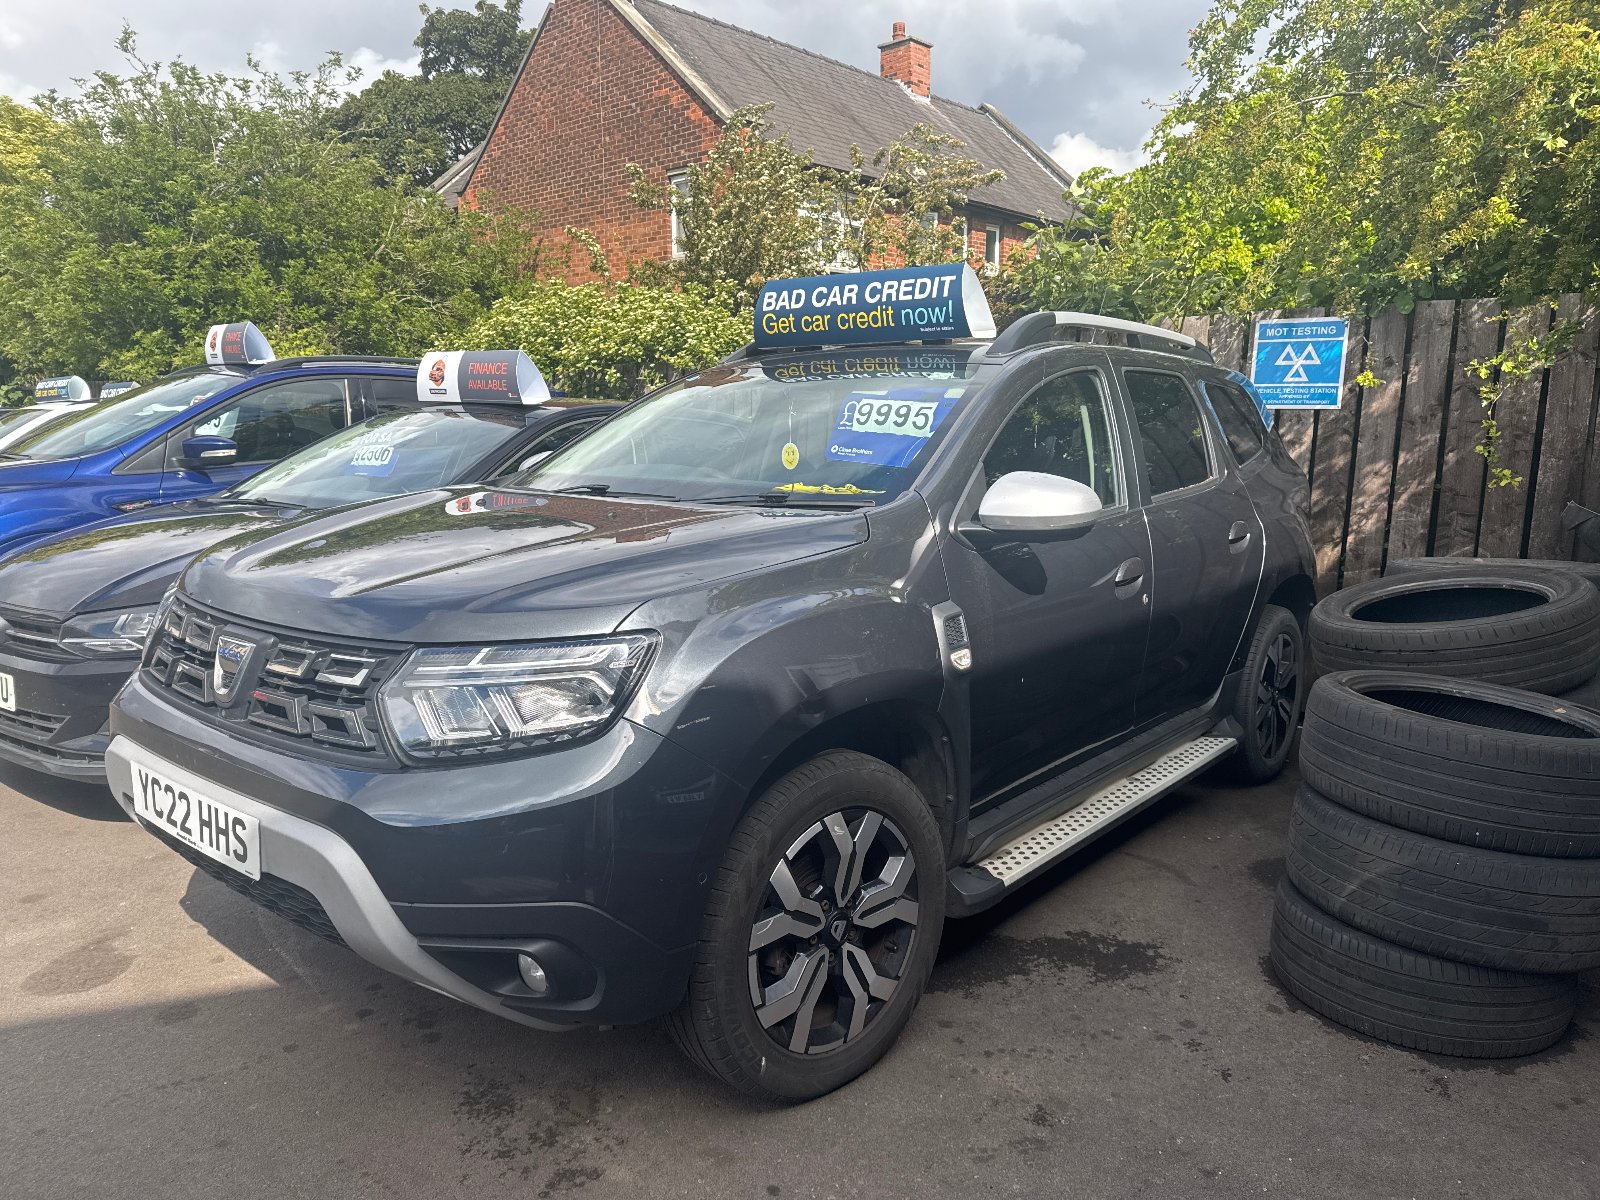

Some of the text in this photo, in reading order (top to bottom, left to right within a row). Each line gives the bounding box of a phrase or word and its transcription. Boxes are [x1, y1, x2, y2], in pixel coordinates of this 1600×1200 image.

[762, 275, 956, 312] BAD CAR CREDIT
[762, 299, 953, 334] Get car credit now!
[1266, 326, 1336, 336] MOT TESTING
[468, 363, 509, 375] FINANCE
[468, 379, 508, 391] AVAILABLE
[840, 400, 934, 431] £9995
[138, 769, 248, 864] YC22 HHS
